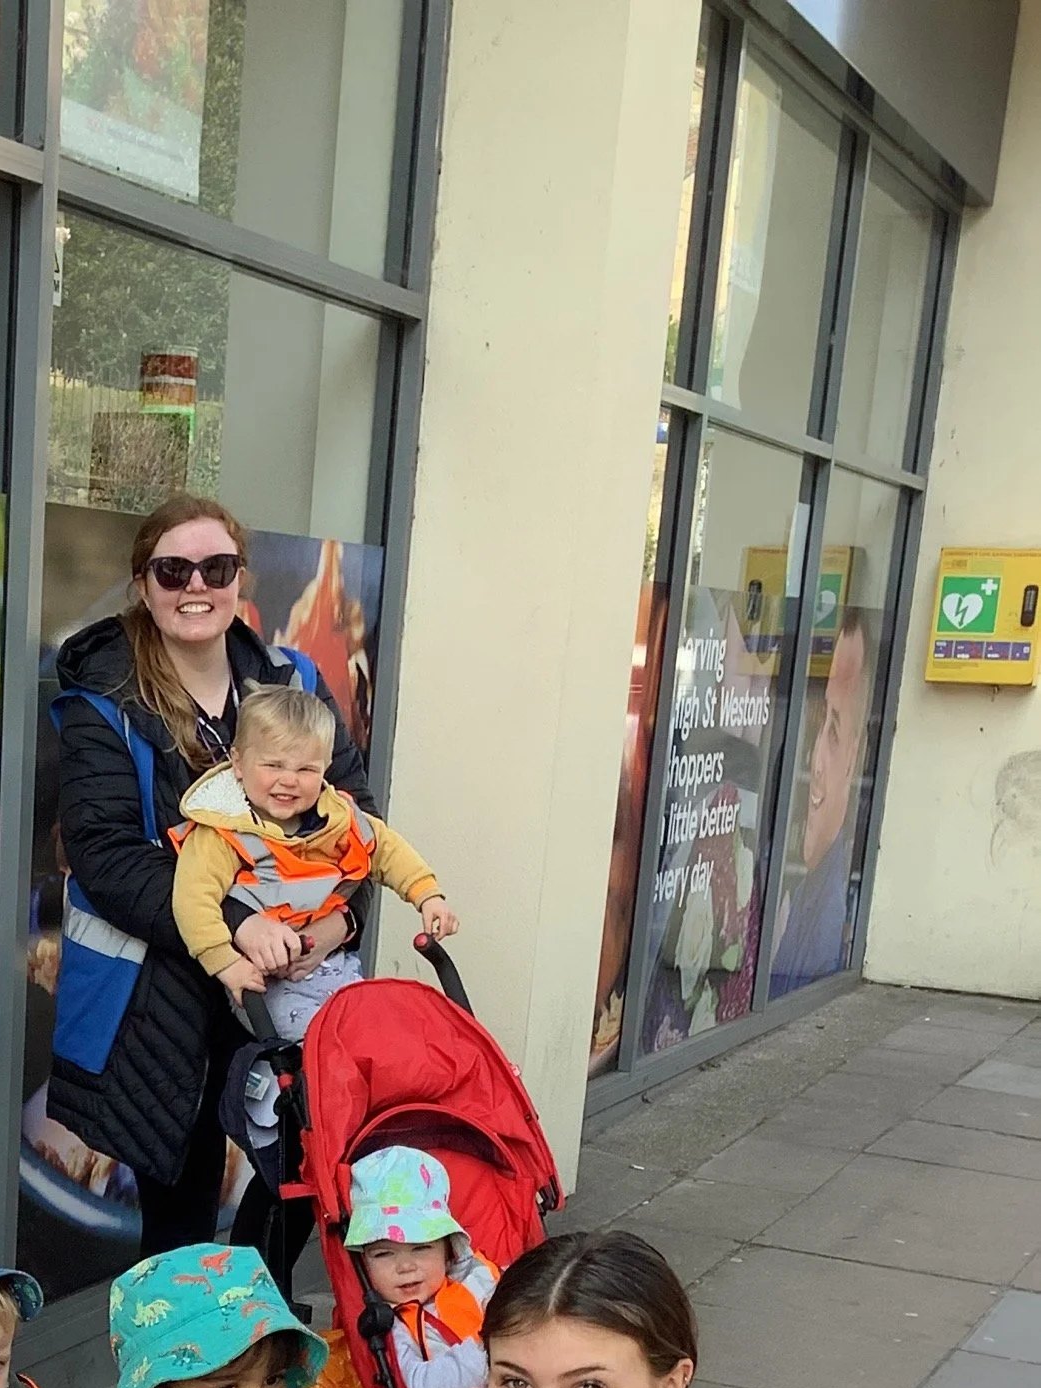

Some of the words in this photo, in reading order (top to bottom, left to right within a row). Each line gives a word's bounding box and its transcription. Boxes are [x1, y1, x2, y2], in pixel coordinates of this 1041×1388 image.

[680, 627, 727, 683] erving
[702, 686, 718, 728] St
[719, 686, 771, 727] Weston's
[668, 745, 725, 797] hoppers
[667, 801, 698, 845] little
[698, 799, 741, 839] better
[690, 853, 715, 900] day
